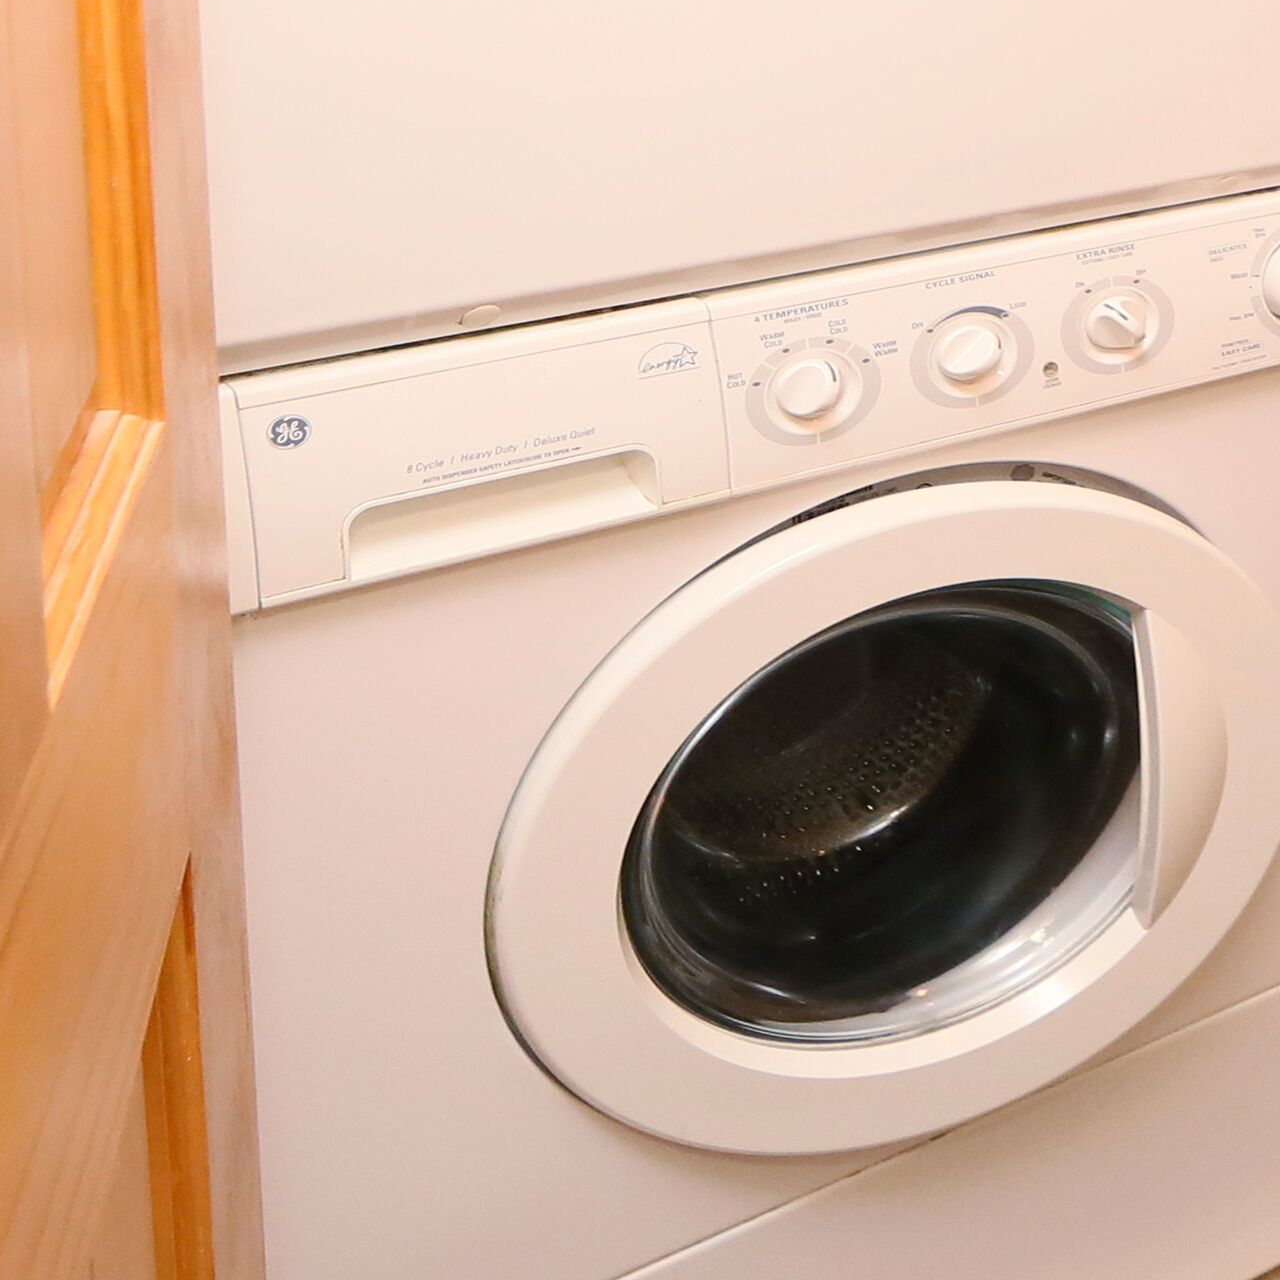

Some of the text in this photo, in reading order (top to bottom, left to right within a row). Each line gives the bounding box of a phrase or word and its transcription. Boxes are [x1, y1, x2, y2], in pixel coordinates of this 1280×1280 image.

[1076, 243, 1136, 260] EXTRA RINSE
[925, 270, 997, 289] CYCLE SIGNAL
[763, 298, 849, 322] TEMPERATURES
[406, 465, 413, 474] 8
[415, 459, 445, 474] Cycle
[460, 451, 492, 464] Heavy
[494, 444, 519, 457] Duty
[533, 433, 568, 448] Deluxe
[569, 426, 596, 440] Quiet
